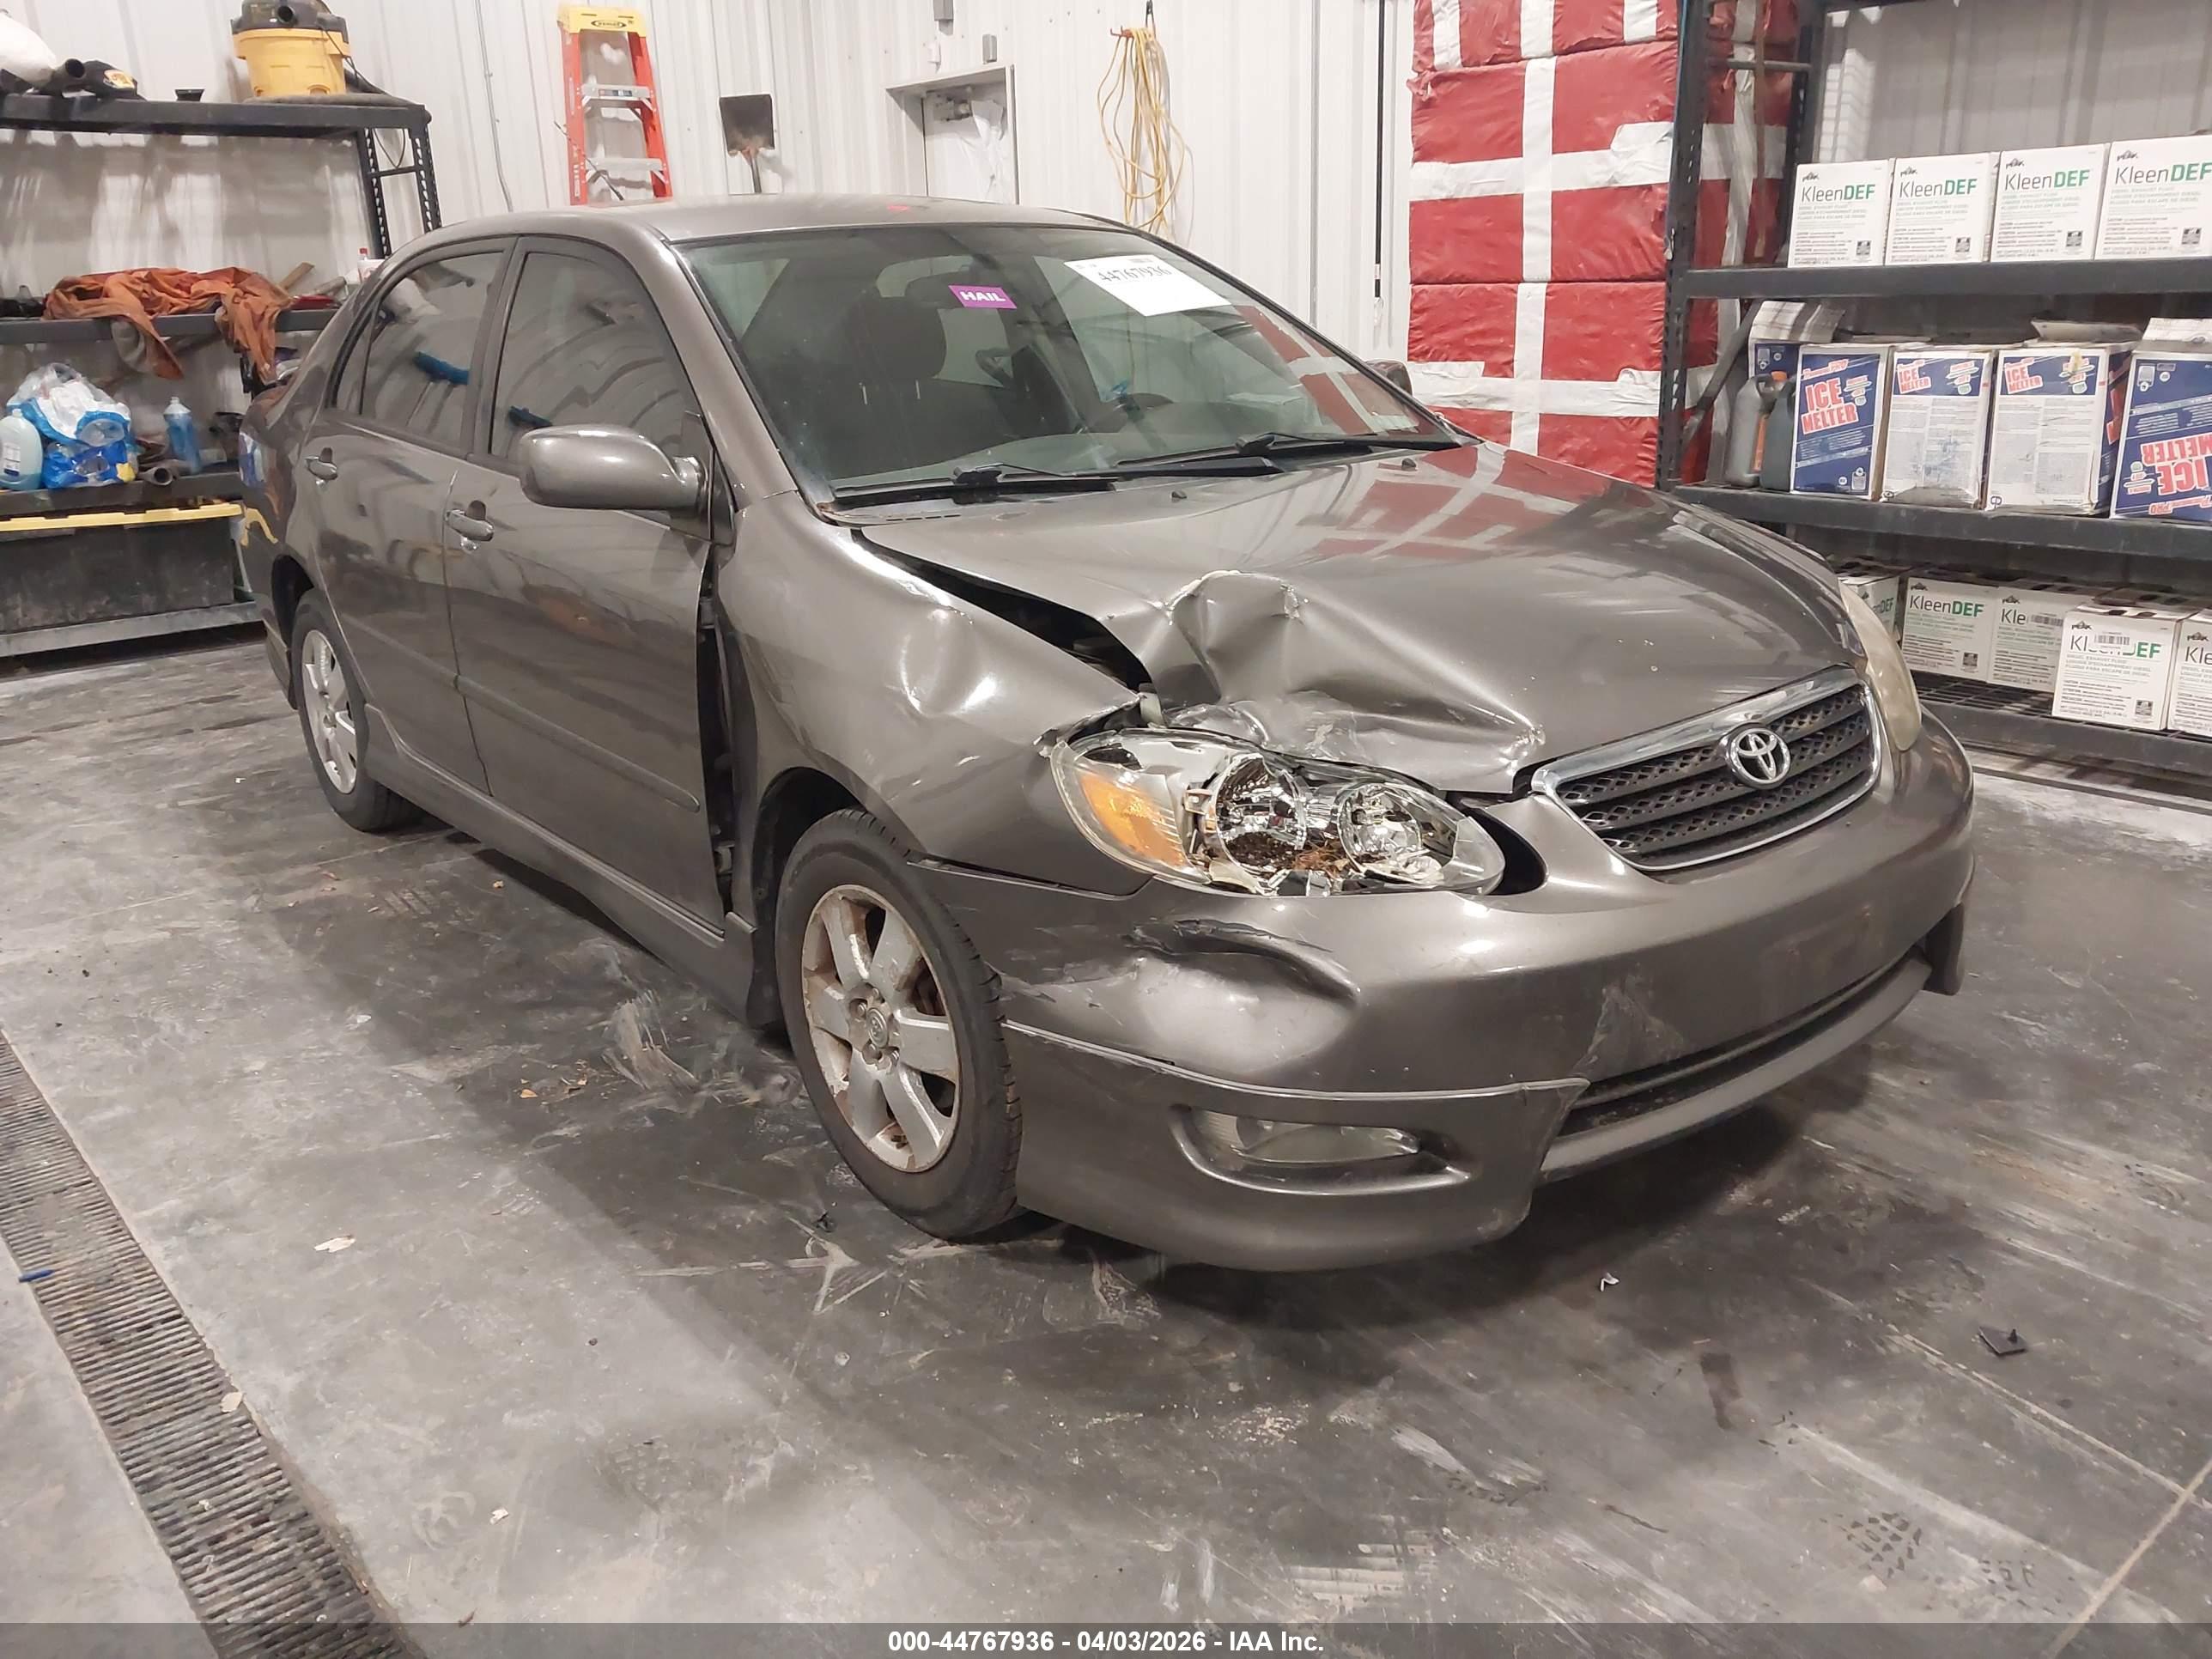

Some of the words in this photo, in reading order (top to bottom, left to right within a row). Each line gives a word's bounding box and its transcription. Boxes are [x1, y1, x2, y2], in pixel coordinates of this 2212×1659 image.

[2005, 169, 2090, 191] KleenDEF
[2115, 162, 2212, 185] KleenDEF
[1802, 184, 1875, 203] KleenDEF
[1899, 178, 1978, 198] KleenDEF
[959, 291, 1006, 302] HAIL
[1899, 368, 1918, 383] ICE
[2007, 367, 2027, 383] ICE
[1806, 378, 1842, 411] ICE
[1802, 404, 1857, 433] MELTER
[2142, 434, 2212, 465] MELTER
[2157, 459, 2209, 495] ICE
[1909, 595, 1984, 617] KleenDEF
